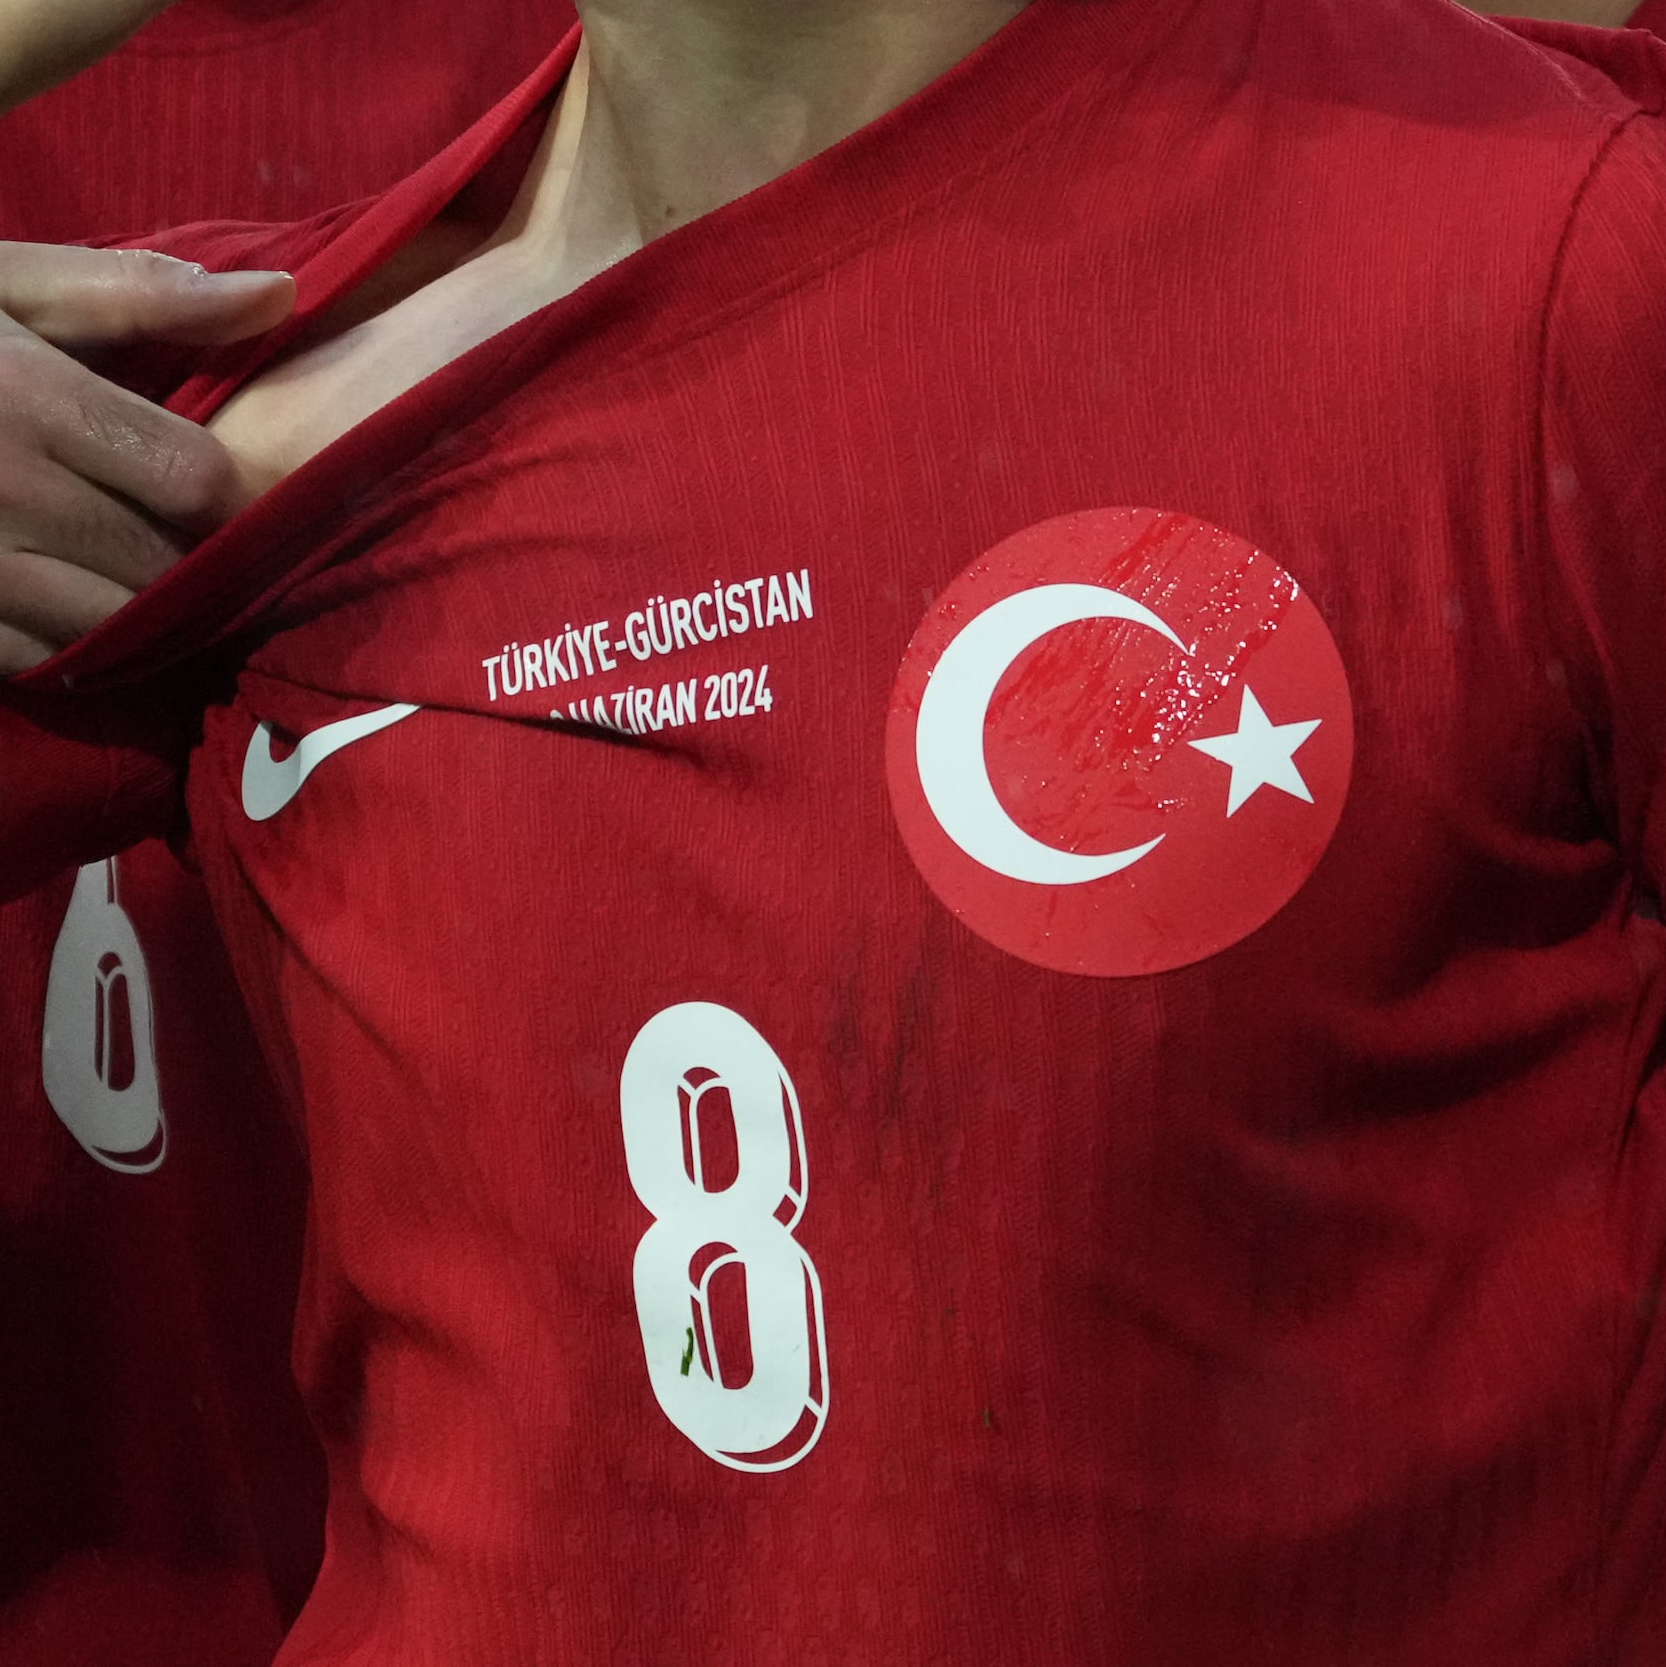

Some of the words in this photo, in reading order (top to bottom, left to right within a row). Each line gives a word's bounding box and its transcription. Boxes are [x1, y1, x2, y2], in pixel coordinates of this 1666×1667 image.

[481, 568, 814, 702] TÜRKİYE-GÜRCİSTAN
[703, 664, 773, 722] 2024
[619, 1000, 831, 1474] 8
